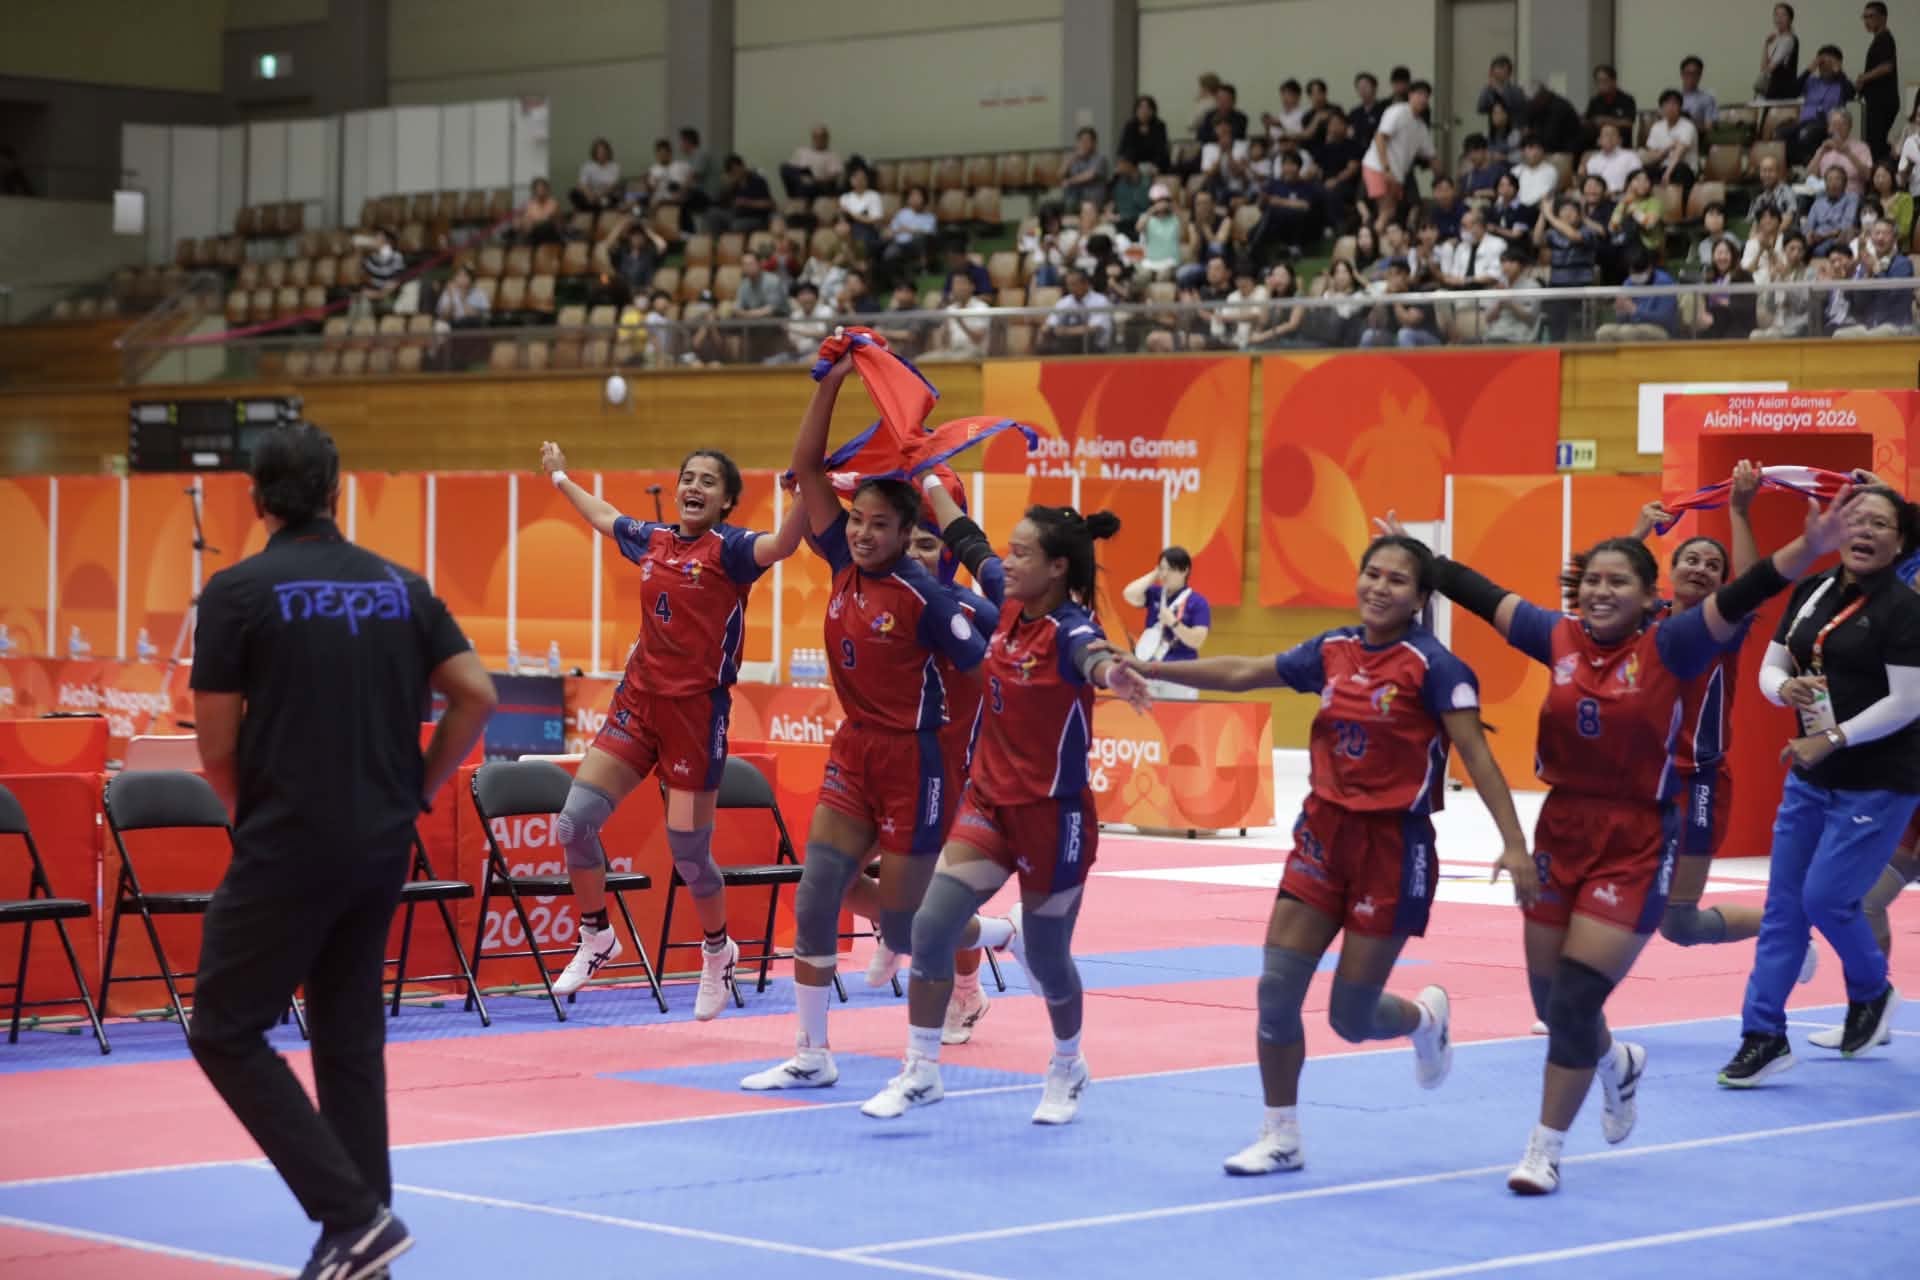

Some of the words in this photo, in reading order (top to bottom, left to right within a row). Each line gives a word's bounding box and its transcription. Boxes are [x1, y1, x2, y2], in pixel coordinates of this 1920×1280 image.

[1704, 409, 1812, 431] Aichi-Nagoya
[1816, 409, 1857, 427] 2026
[1729, 396, 1754, 409] 20th
[1757, 396, 1788, 409] Asian
[1791, 395, 1832, 409] Games
[1074, 434, 1126, 458] Asian
[1129, 436, 1198, 458] Games
[655, 591, 672, 624] 4
[841, 637, 857, 670] 9
[989, 676, 1004, 715] 3
[1576, 697, 1602, 738] 8
[1698, 784, 1710, 827] PACE
[1066, 811, 1081, 864] PACE
[481, 904, 575, 950] 2026
